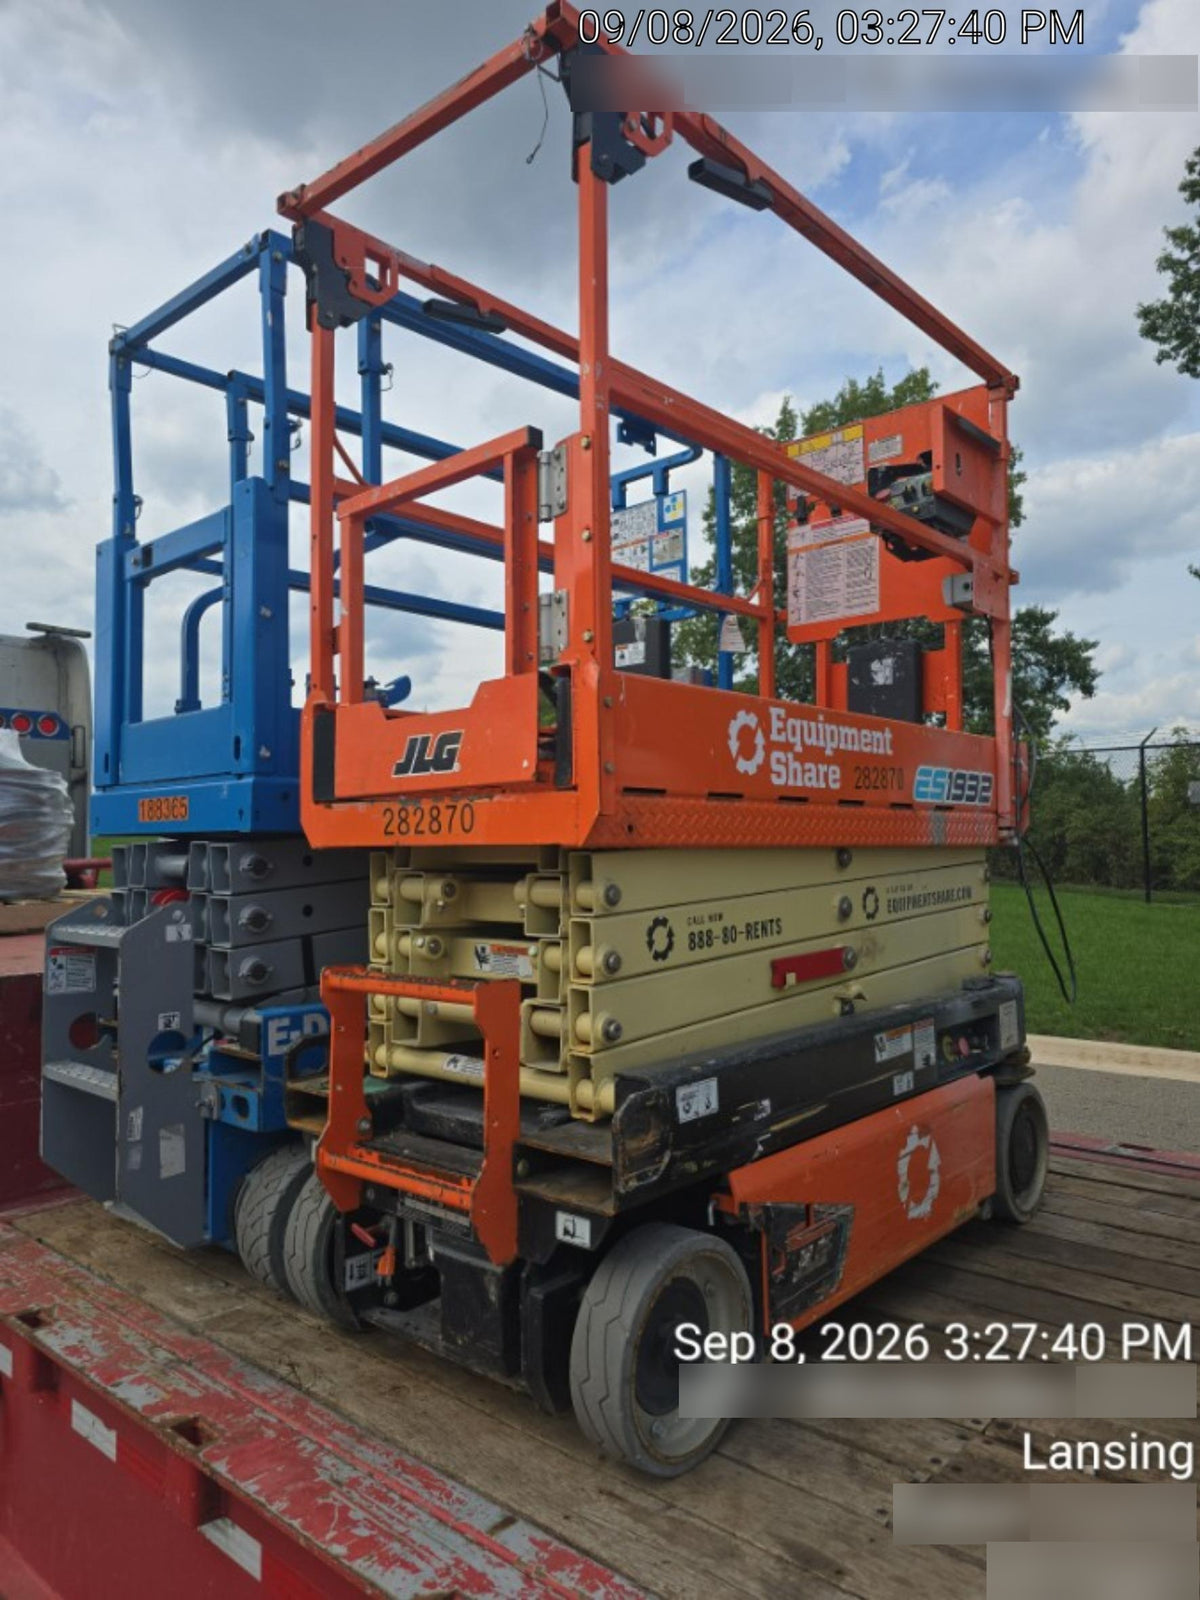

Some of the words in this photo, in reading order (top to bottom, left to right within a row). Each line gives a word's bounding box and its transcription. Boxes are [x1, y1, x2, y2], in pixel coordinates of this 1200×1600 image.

[769, 706, 894, 755] Equipment
[391, 729, 464, 778] JLG
[770, 751, 841, 790] Share
[853, 766, 904, 791] 282870
[913, 765, 994, 806] ES1932
[382, 802, 475, 836] 282870
[688, 917, 783, 951] 888-80-RENTS
